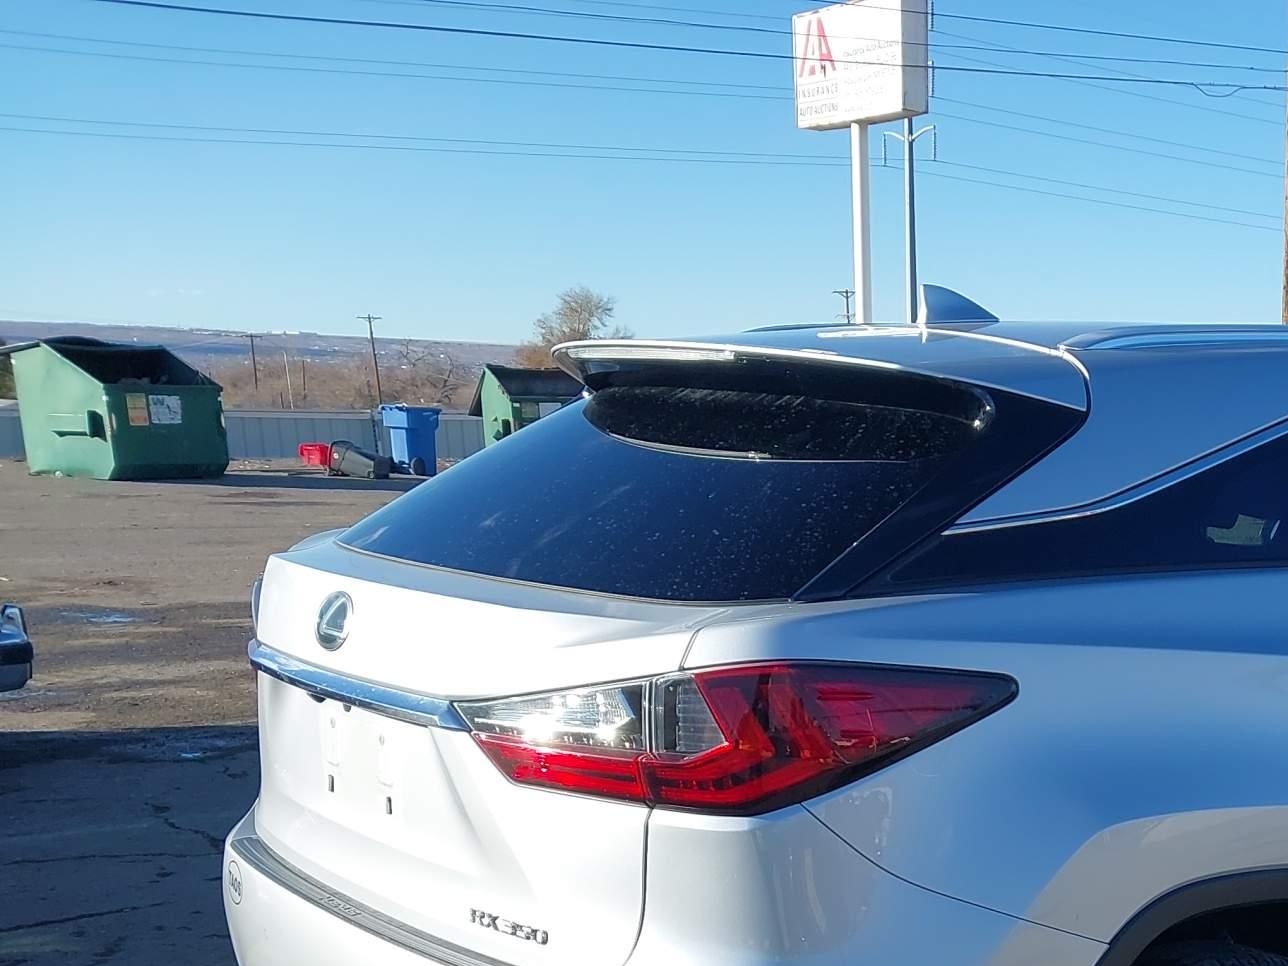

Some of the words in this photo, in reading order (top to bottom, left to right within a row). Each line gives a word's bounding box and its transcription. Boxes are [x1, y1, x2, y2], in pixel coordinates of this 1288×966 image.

[798, 82, 839, 99] INSURANCE
[799, 104, 813, 116] AUTO
[814, 102, 839, 114] AUCTIONS
[469, 907, 500, 932] RX
[501, 919, 548, 946] 350
